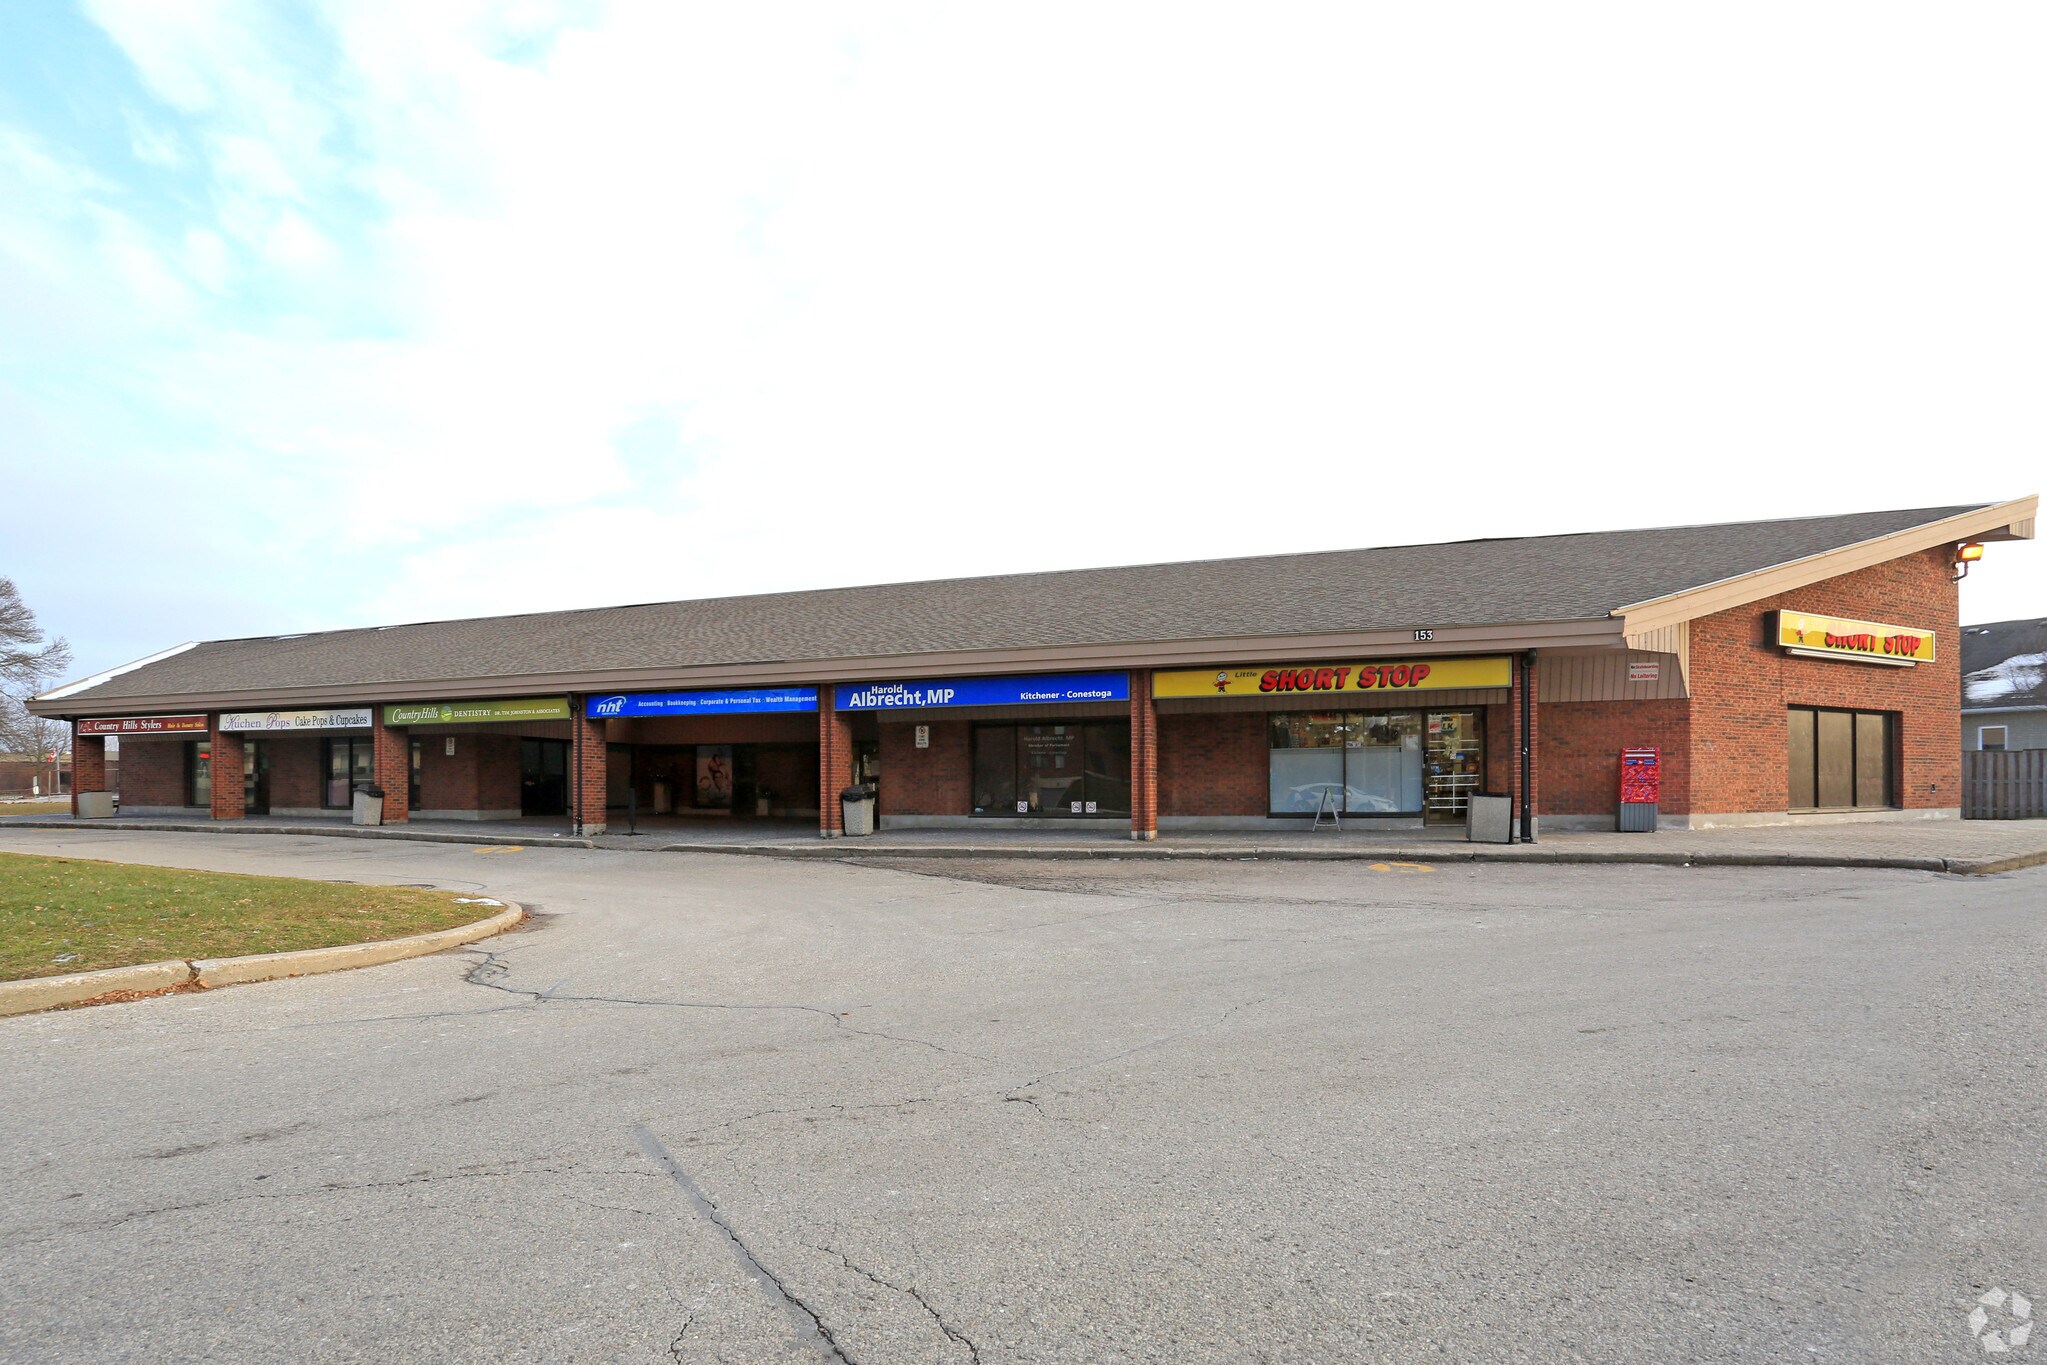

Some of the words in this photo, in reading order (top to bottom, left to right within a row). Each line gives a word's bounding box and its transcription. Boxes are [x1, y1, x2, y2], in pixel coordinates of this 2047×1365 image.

[1414, 630, 1433, 641] 153
[1259, 667, 1351, 692] SHORT
[1357, 664, 1431, 689] STOP
[871, 684, 903, 694] Harold
[1020, 691, 1060, 700] Kitchener
[1066, 690, 1112, 699] Conestoga
[667, 699, 696, 707] Bookkeeping
[700, 698, 724, 706] Corporate
[454, 709, 491, 717] DENTISTRY
[94, 721, 119, 732] Country
[122, 720, 138, 730] Hills
[140, 719, 162, 731] Stylers
[224, 713, 261, 730] Kuchen
[266, 712, 290, 730] Pops
[295, 715, 311, 727] Cake
[312, 715, 327, 727] Pops
[329, 715, 334, 726] &
[335, 714, 368, 727] Cupcakes
